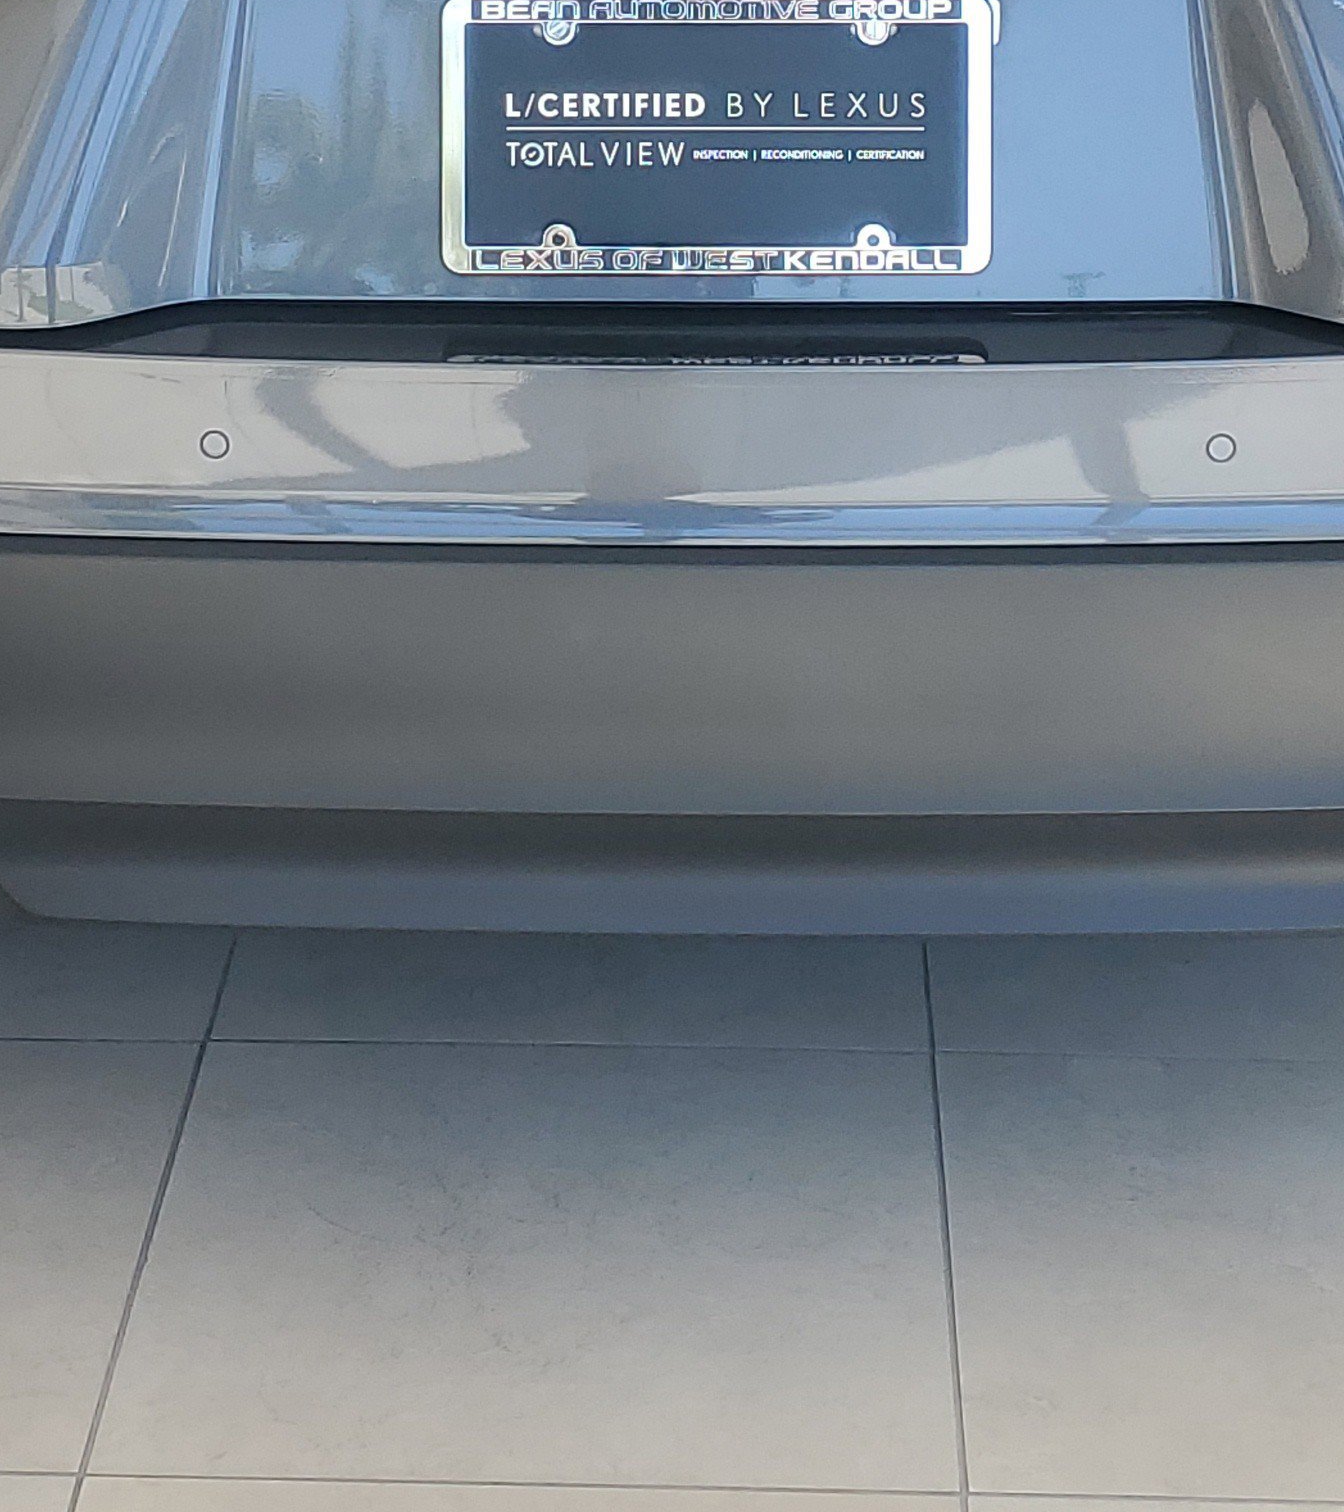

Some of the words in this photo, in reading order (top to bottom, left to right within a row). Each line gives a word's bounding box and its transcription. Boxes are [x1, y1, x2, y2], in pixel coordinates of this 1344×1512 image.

[481, 0, 580, 20] BEAN
[589, 0, 819, 20] AUTOMOTIVE
[828, 0, 952, 20] GROUP
[505, 92, 706, 118] L/CERTIFIED
[726, 92, 773, 118] BY
[793, 92, 925, 118] LEXUS
[505, 141, 595, 168] TOTAL
[600, 141, 685, 167] VIEW
[692, 149, 749, 161] INSPECTION
[760, 149, 844, 161] RECONDITIONING
[855, 149, 925, 161] CERTIFICATION
[475, 249, 605, 271] LEXUS
[612, 249, 664, 271] OF
